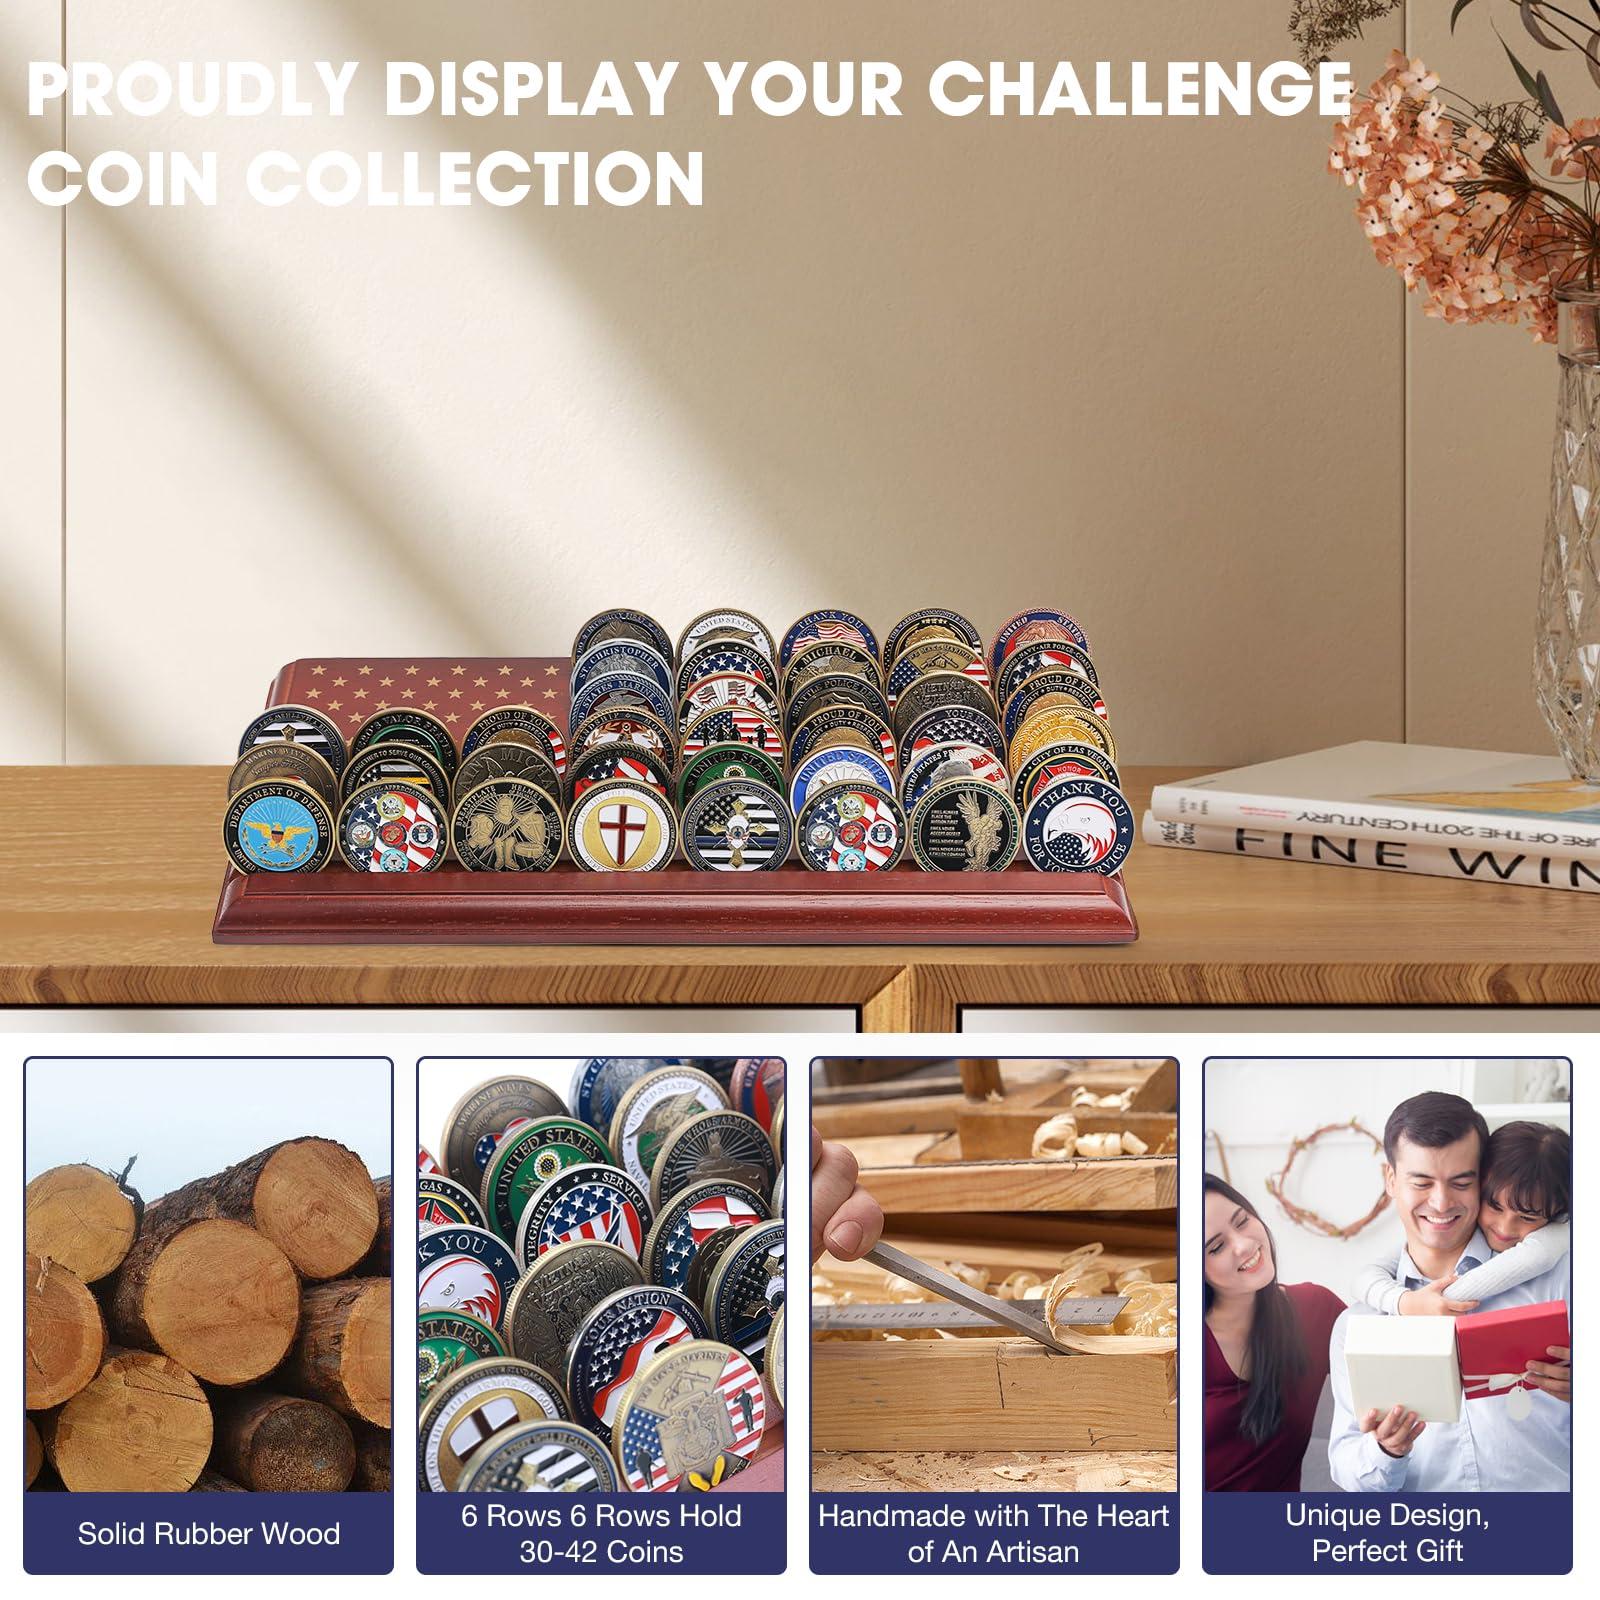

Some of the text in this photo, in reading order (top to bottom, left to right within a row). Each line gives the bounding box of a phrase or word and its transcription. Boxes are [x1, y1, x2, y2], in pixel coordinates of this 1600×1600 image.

[695, 617, 756, 634] UNITED STATES
[798, 612, 865, 629] THANK YOU
[1000, 617, 1028, 644] UNITED
[1057, 617, 1084, 644] STATES
[1052, 643, 1074, 652] FORCE
[579, 646, 660, 680] ST. CHRISTOPHER
[680, 648, 774, 692] TEGRITY SERVICE
[789, 646, 858, 682] ST. MICHAEL
[582, 680, 657, 710] STATES MARINE
[792, 682, 824, 718] SEATTLE
[824, 680, 861, 688] POLICE
[1029, 675, 1063, 690] PROUD
[1065, 676, 1079, 685] OF
[1079, 681, 1098, 699] YOU
[1021, 690, 1041, 713] LOYALTY
[479, 711, 511, 730] PROUD
[513, 711, 528, 721] OF
[528, 714, 551, 734] YOU
[812, 710, 882, 732] PROUD OF YOU
[944, 709, 1003, 748] YOUR NATION
[1087, 722, 1105, 746] NAVY
[806, 727, 825, 750] LOYALTY
[245, 749, 279, 767] MARINE
[281, 749, 312, 762] WIVES
[379, 750, 388, 758] TO
[388, 749, 408, 758] SERVE
[408, 752, 422, 763] OUR
[695, 751, 778, 788] UNITED STATES
[800, 750, 845, 784] UNITED
[846, 751, 888, 785] STATES
[917, 752, 943, 775] STATES
[1031, 746, 1111, 771] CITY OF LAS VEGAS
[384, 785, 431, 804] APPRECIATION
[456, 785, 497, 826] BREASTPLATE
[511, 784, 545, 801] HELMET
[1040, 782, 1097, 810] THANK
[1101, 786, 1128, 818] YOU
[230, 787, 329, 839] DEPARTMENT OF DEFENSE
[548, 811, 561, 841] SHIELD
[1296, 810, 1559, 846] OF THE 20TH CENTURY
[1029, 835, 1047, 862] FOR
[1235, 827, 1408, 869] FINE
[581, 1075, 597, 1099] ST.
[457, 1083, 532, 1127] MARINE WIVES
[629, 1081, 698, 1127] UNITED STATES
[498, 1128, 601, 1197] UNITED STATES
[662, 1167, 672, 1185] ON
[419, 1180, 444, 1194] GAS
[602, 1172, 645, 1213] SERVICE
[685, 1193, 699, 1210] AIR
[439, 1233, 489, 1255] YOU
[583, 1291, 672, 1347] YOUR NATION
[419, 1320, 484, 1348] STATES
